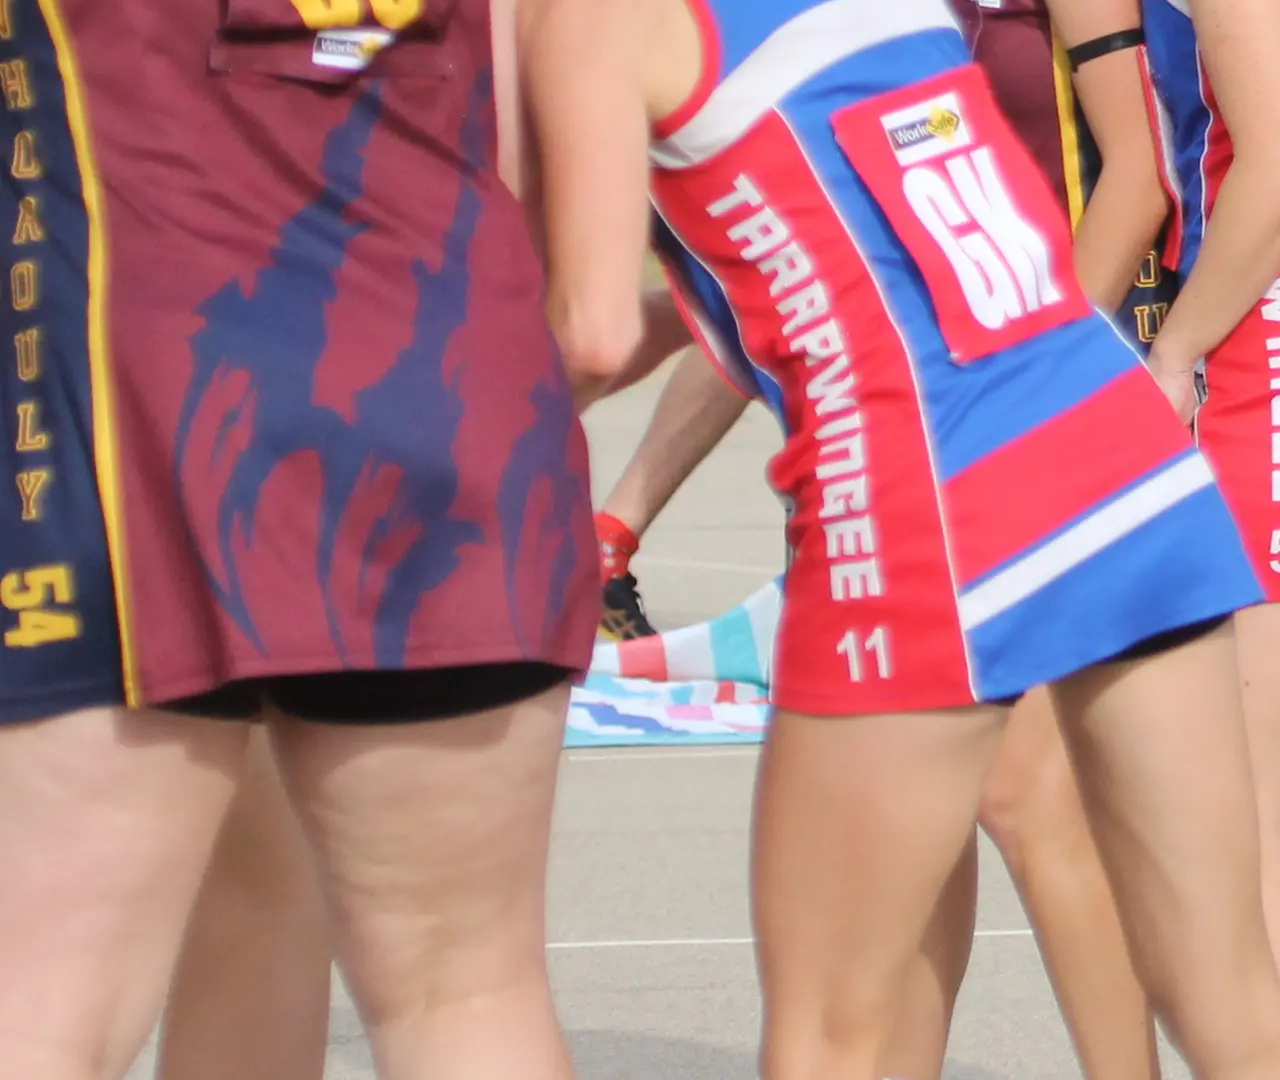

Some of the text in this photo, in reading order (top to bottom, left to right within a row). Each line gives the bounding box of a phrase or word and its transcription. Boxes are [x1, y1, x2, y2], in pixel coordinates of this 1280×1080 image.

[902, 147, 1063, 330] GK
[0, 564, 80, 648] 54
[836, 627, 892, 683] 11
